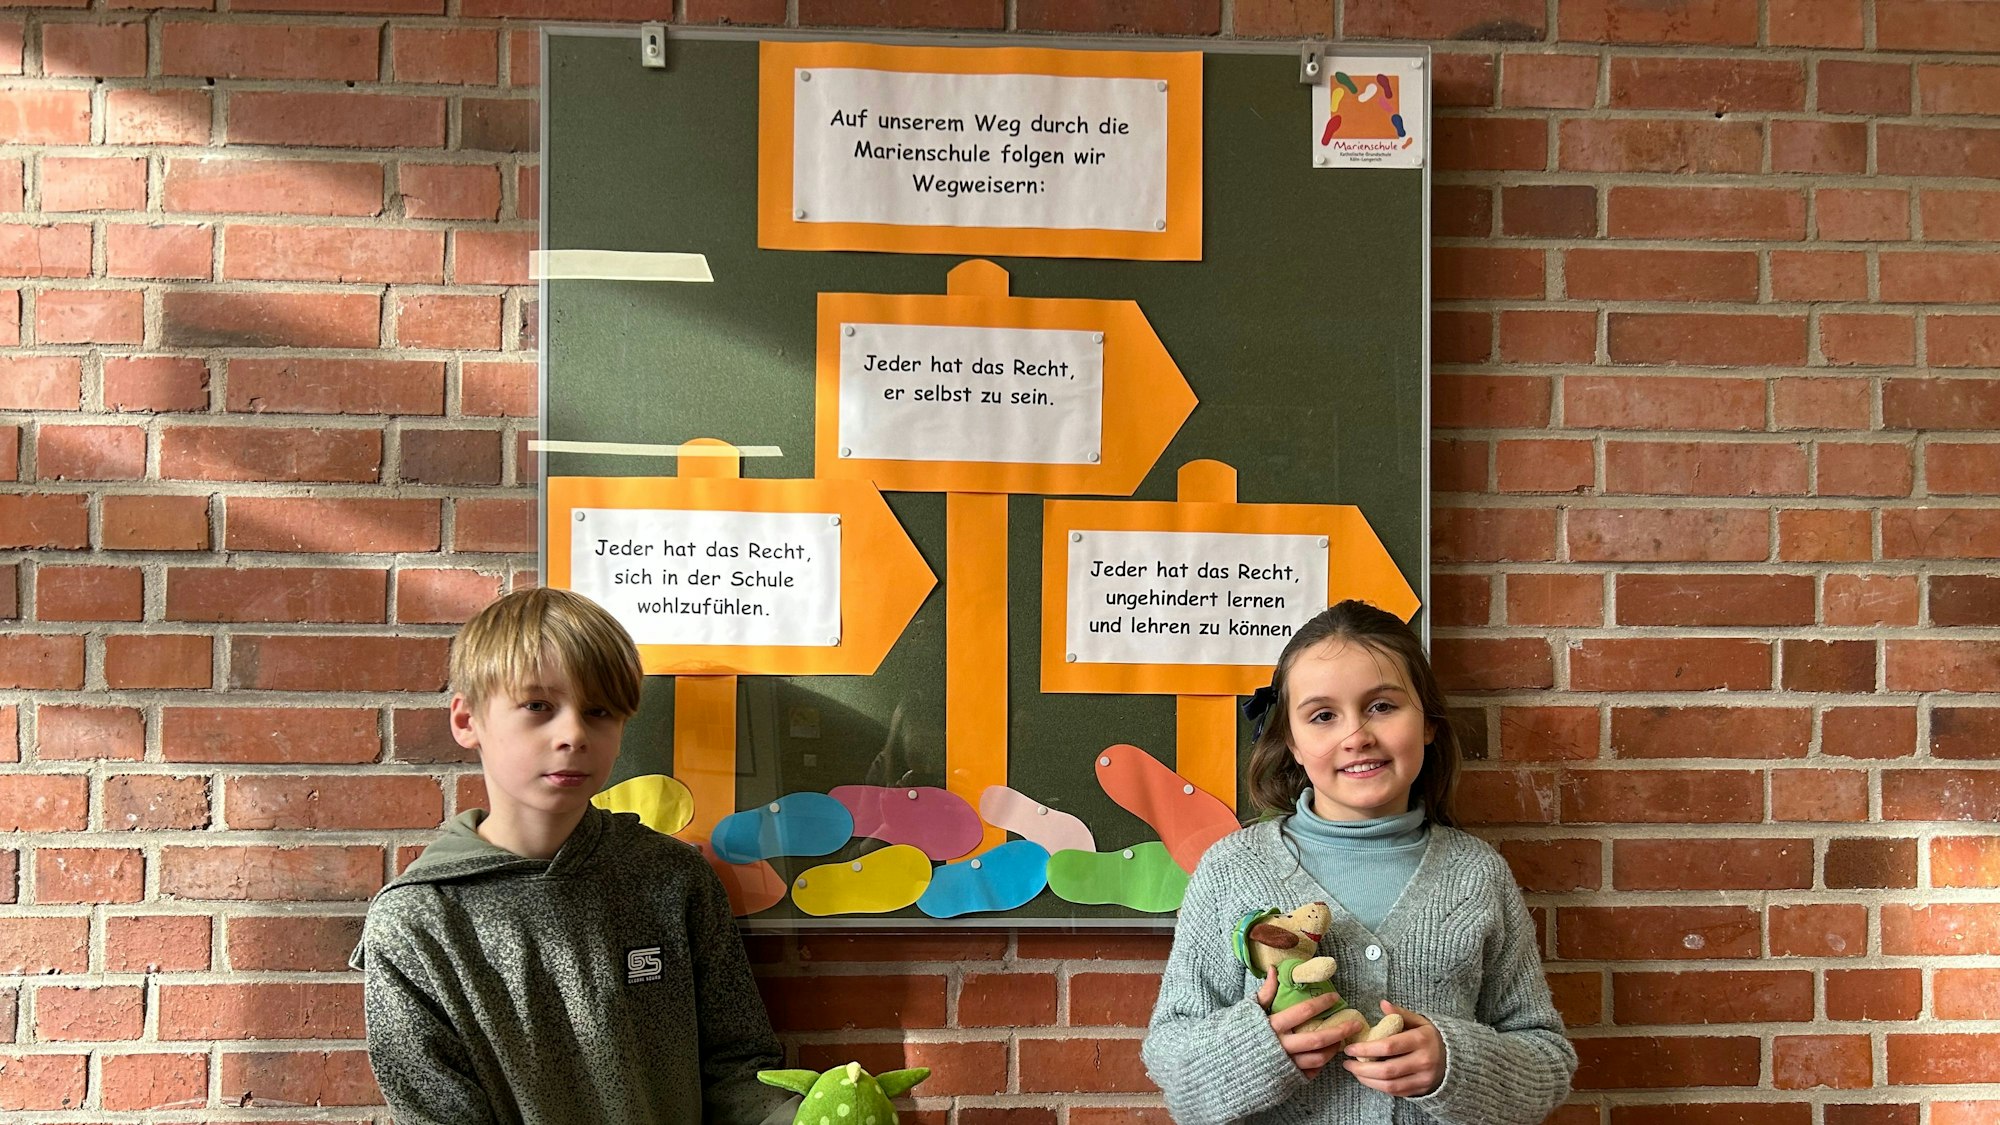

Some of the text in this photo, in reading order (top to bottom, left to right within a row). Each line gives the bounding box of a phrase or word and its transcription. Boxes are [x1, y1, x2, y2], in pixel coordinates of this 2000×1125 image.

[830, 108, 1130, 137] Auf unserem Weg durch die
[853, 140, 1106, 169] Marienschule folgen wir
[1334, 141, 1398, 151] Marienschule
[912, 174, 1045, 198] Wegweisern:
[863, 354, 1075, 380] Jeder hat das Recht,
[884, 384, 1054, 406] er selbst zu sein.
[595, 539, 812, 563] Jeder hat das Recht,
[614, 568, 794, 588] sich in der Schule
[1090, 560, 1300, 583] Jeder hat das Recht,
[637, 597, 770, 616] wohlzufühlen.
[1106, 588, 1285, 609] ungehindert lernen
[1089, 616, 1292, 637] und lehren zu können
